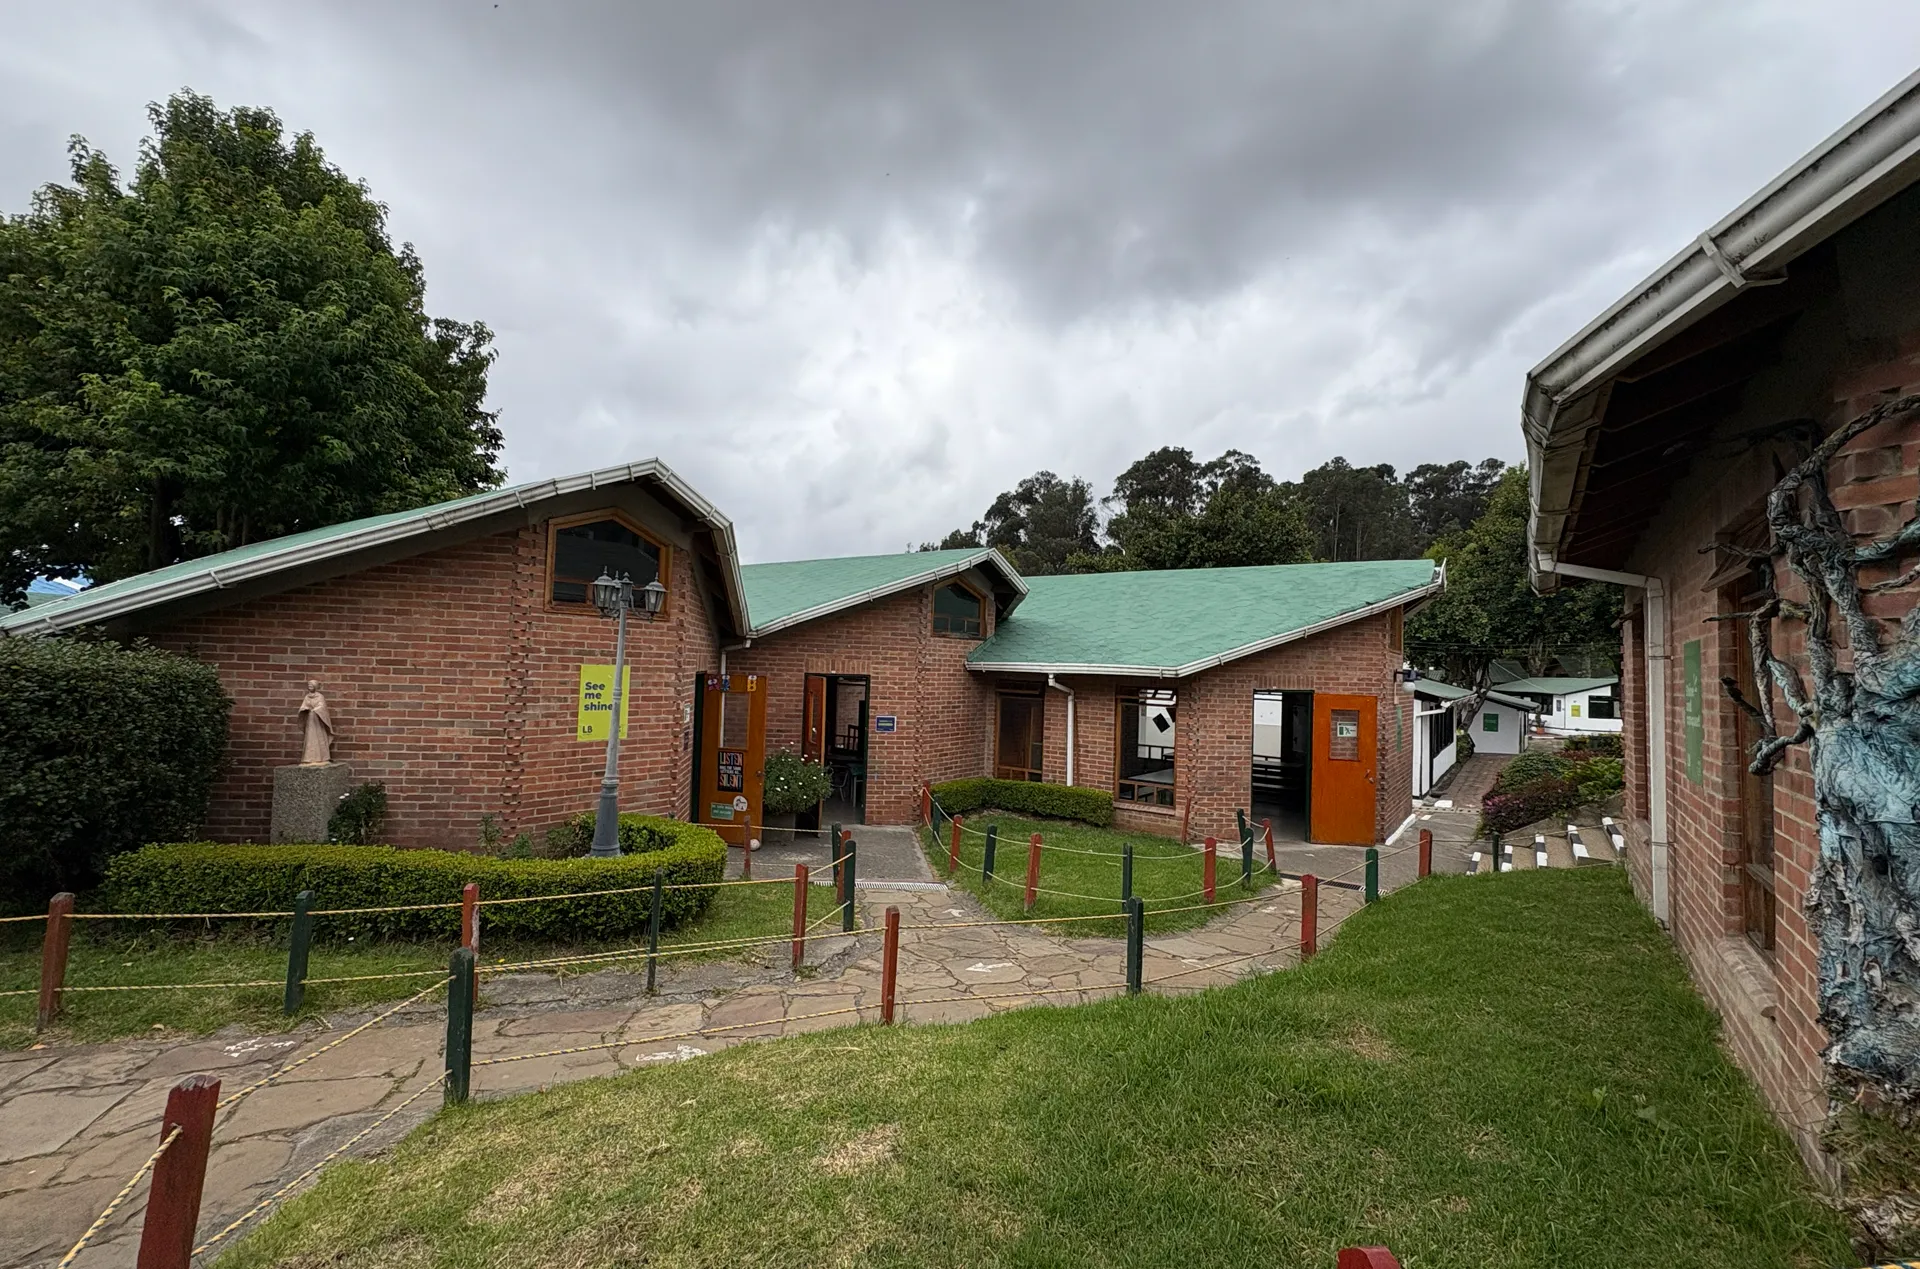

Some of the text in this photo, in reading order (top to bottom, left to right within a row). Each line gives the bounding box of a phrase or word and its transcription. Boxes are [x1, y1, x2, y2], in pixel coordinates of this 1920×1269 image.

[585, 682, 605, 690] See
[584, 702, 613, 711] shine
[582, 726, 592, 734] LB
[719, 752, 743, 766] LISTEN
[719, 774, 743, 790] SILENT
